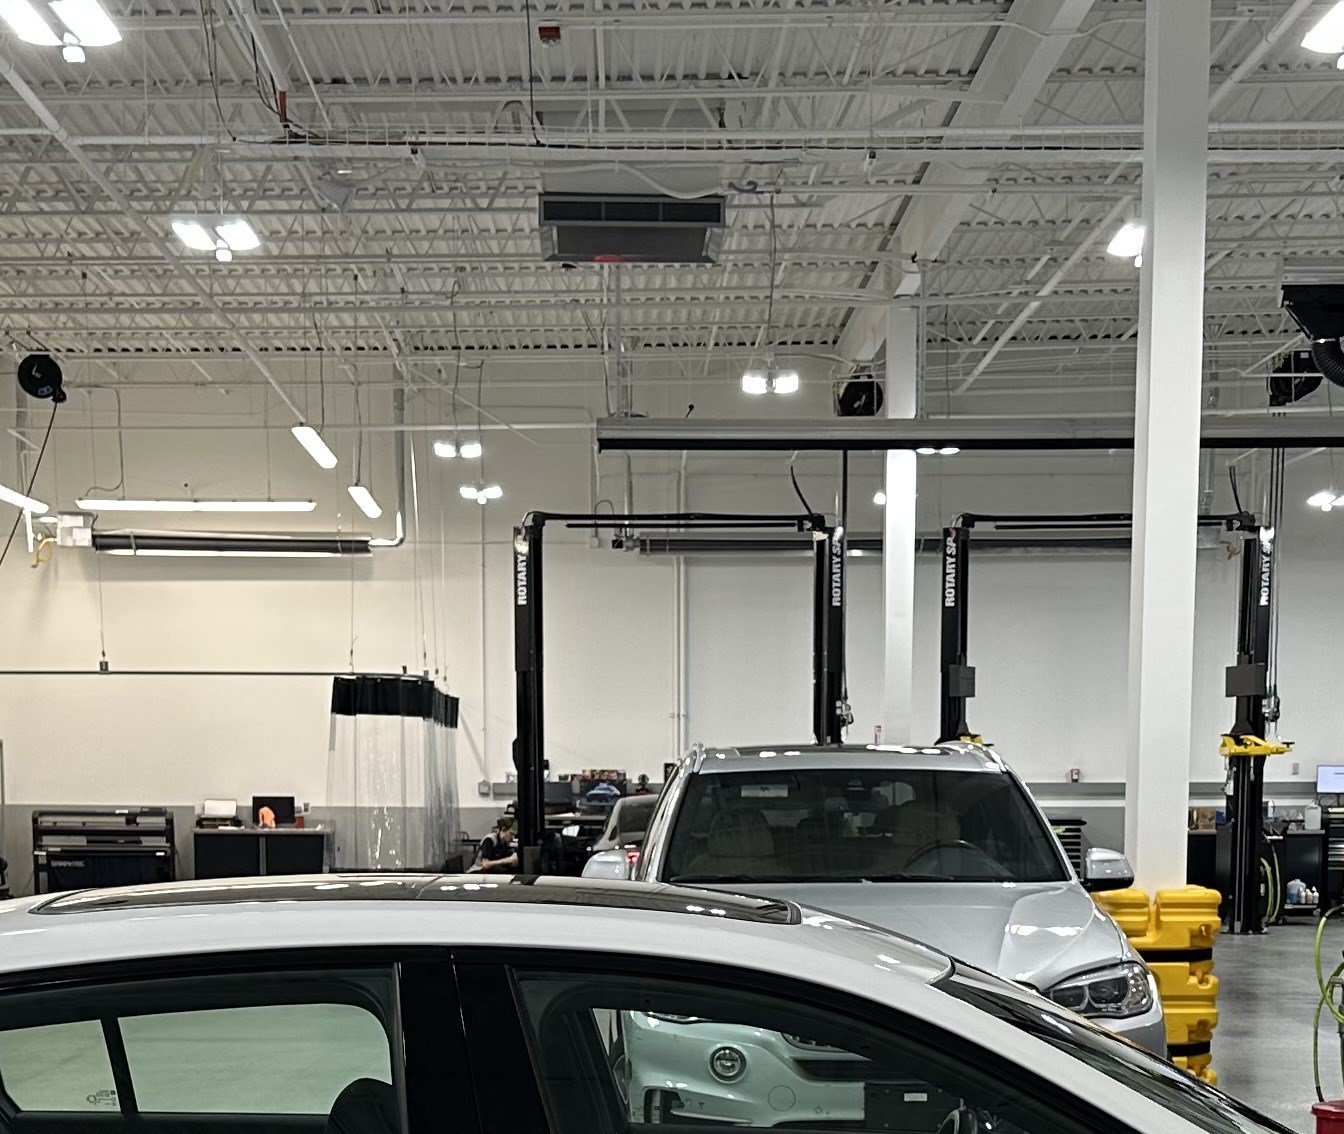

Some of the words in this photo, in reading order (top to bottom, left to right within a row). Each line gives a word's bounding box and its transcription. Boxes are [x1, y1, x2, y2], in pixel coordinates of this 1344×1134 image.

[516, 553, 527, 606] ROTARY
[832, 556, 842, 607] ROTARY
[944, 556, 956, 607] ROTARY
